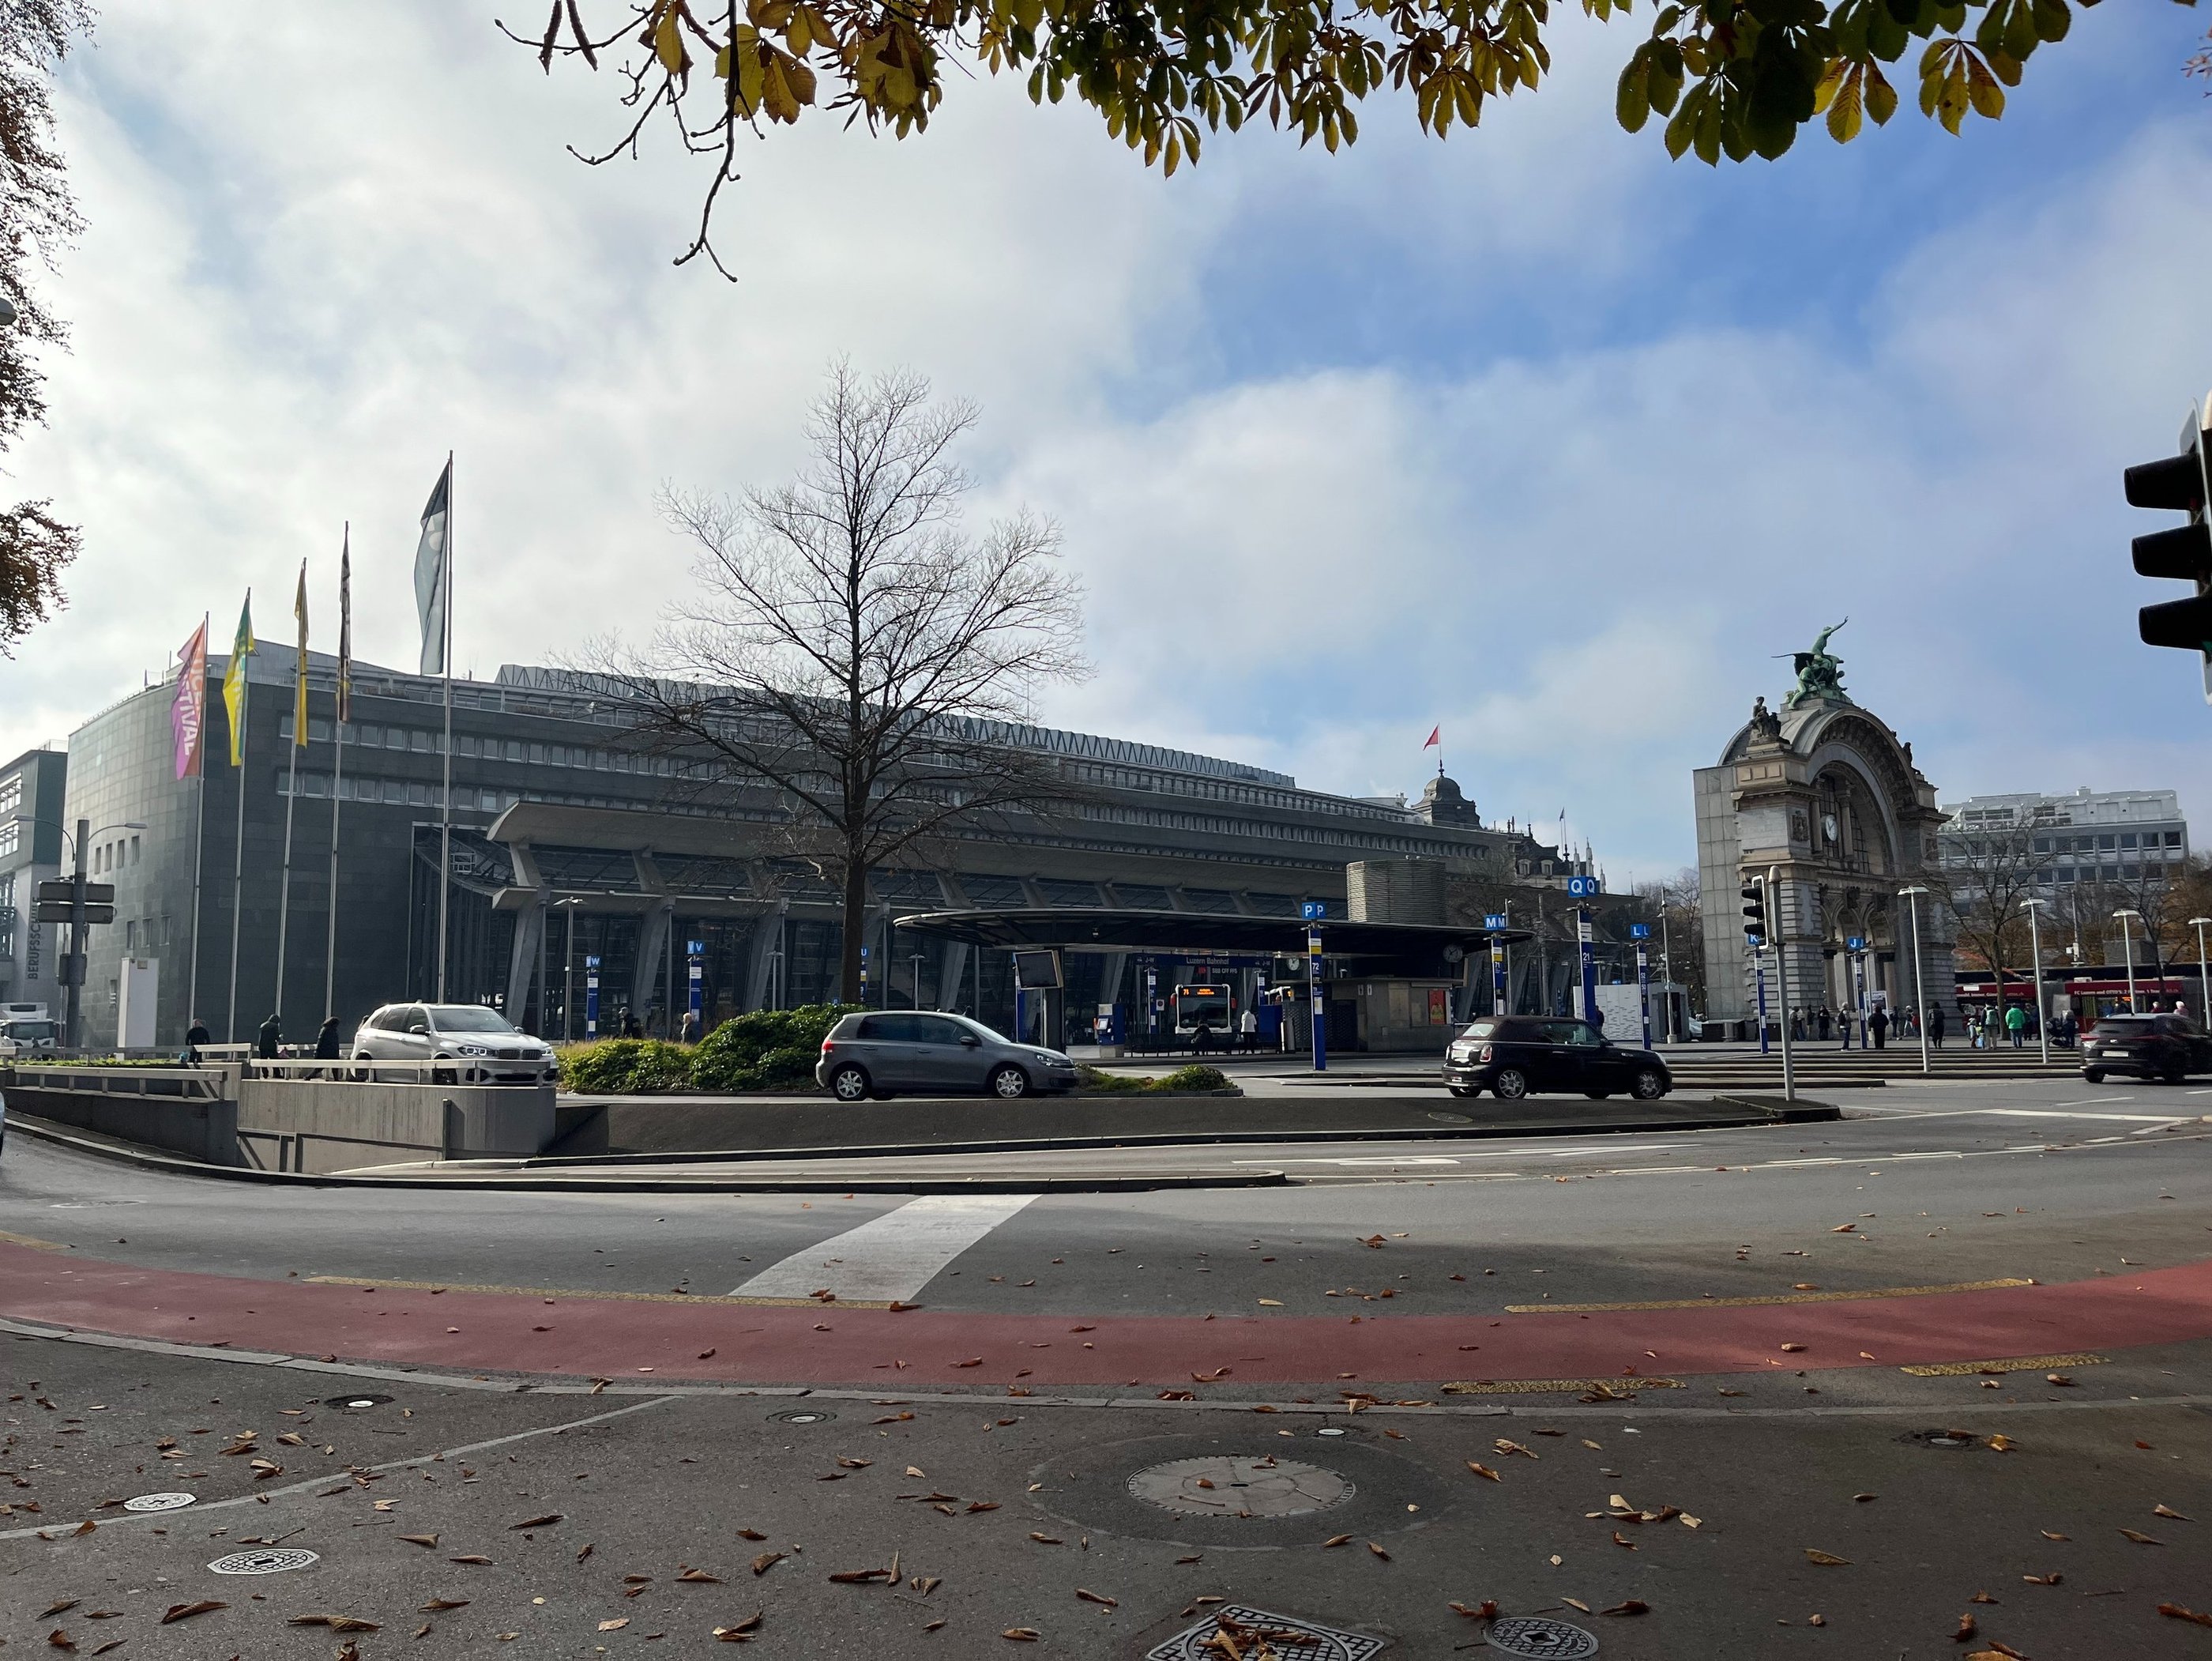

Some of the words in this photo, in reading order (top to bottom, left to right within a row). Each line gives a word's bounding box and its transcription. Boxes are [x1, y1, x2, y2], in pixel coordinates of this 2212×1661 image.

[1571, 879, 1582, 894] Q
[1586, 879, 1595, 894] Q
[1305, 905, 1313, 917] P
[1317, 905, 1323, 916] P
[1486, 917, 1496, 928] M
[1498, 917, 1505, 928] M
[1634, 926, 1640, 936] L
[1644, 926, 1649, 936] L
[695, 943, 702, 951] V
[1850, 938, 1856, 947] J
[1860, 938, 1864, 947] J
[1583, 952, 1590, 961] 21
